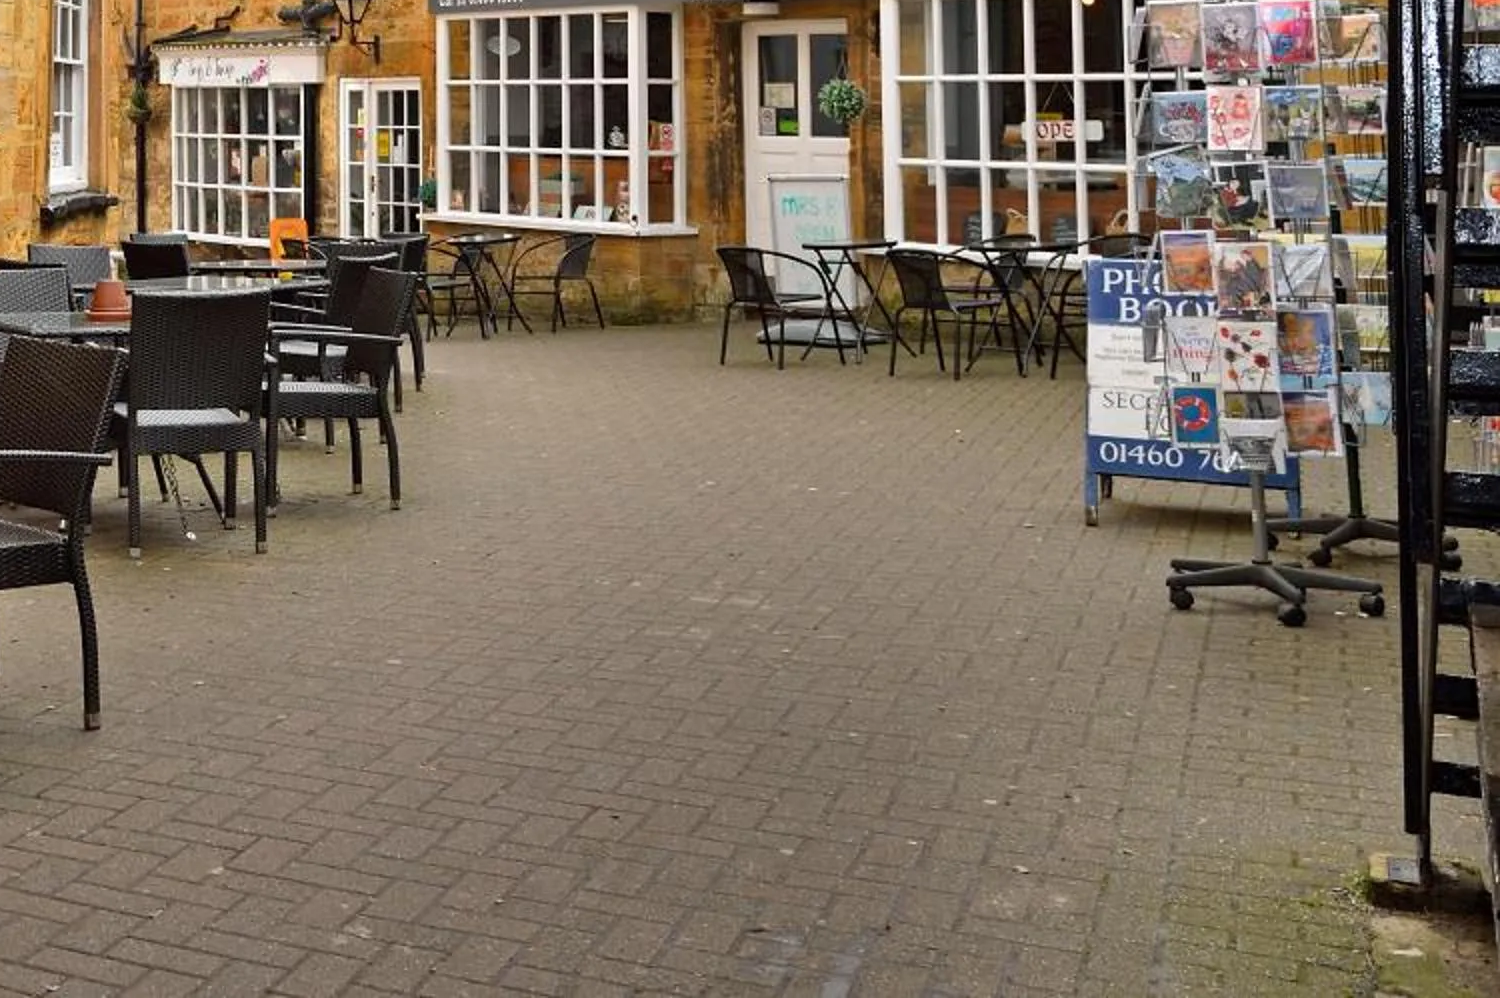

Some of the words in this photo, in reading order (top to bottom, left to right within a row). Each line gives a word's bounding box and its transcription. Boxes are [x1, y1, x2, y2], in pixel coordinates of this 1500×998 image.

[1036, 123, 1074, 139] OPE
[1119, 297, 1217, 323] BOO
[1099, 442, 1184, 468] 01460
